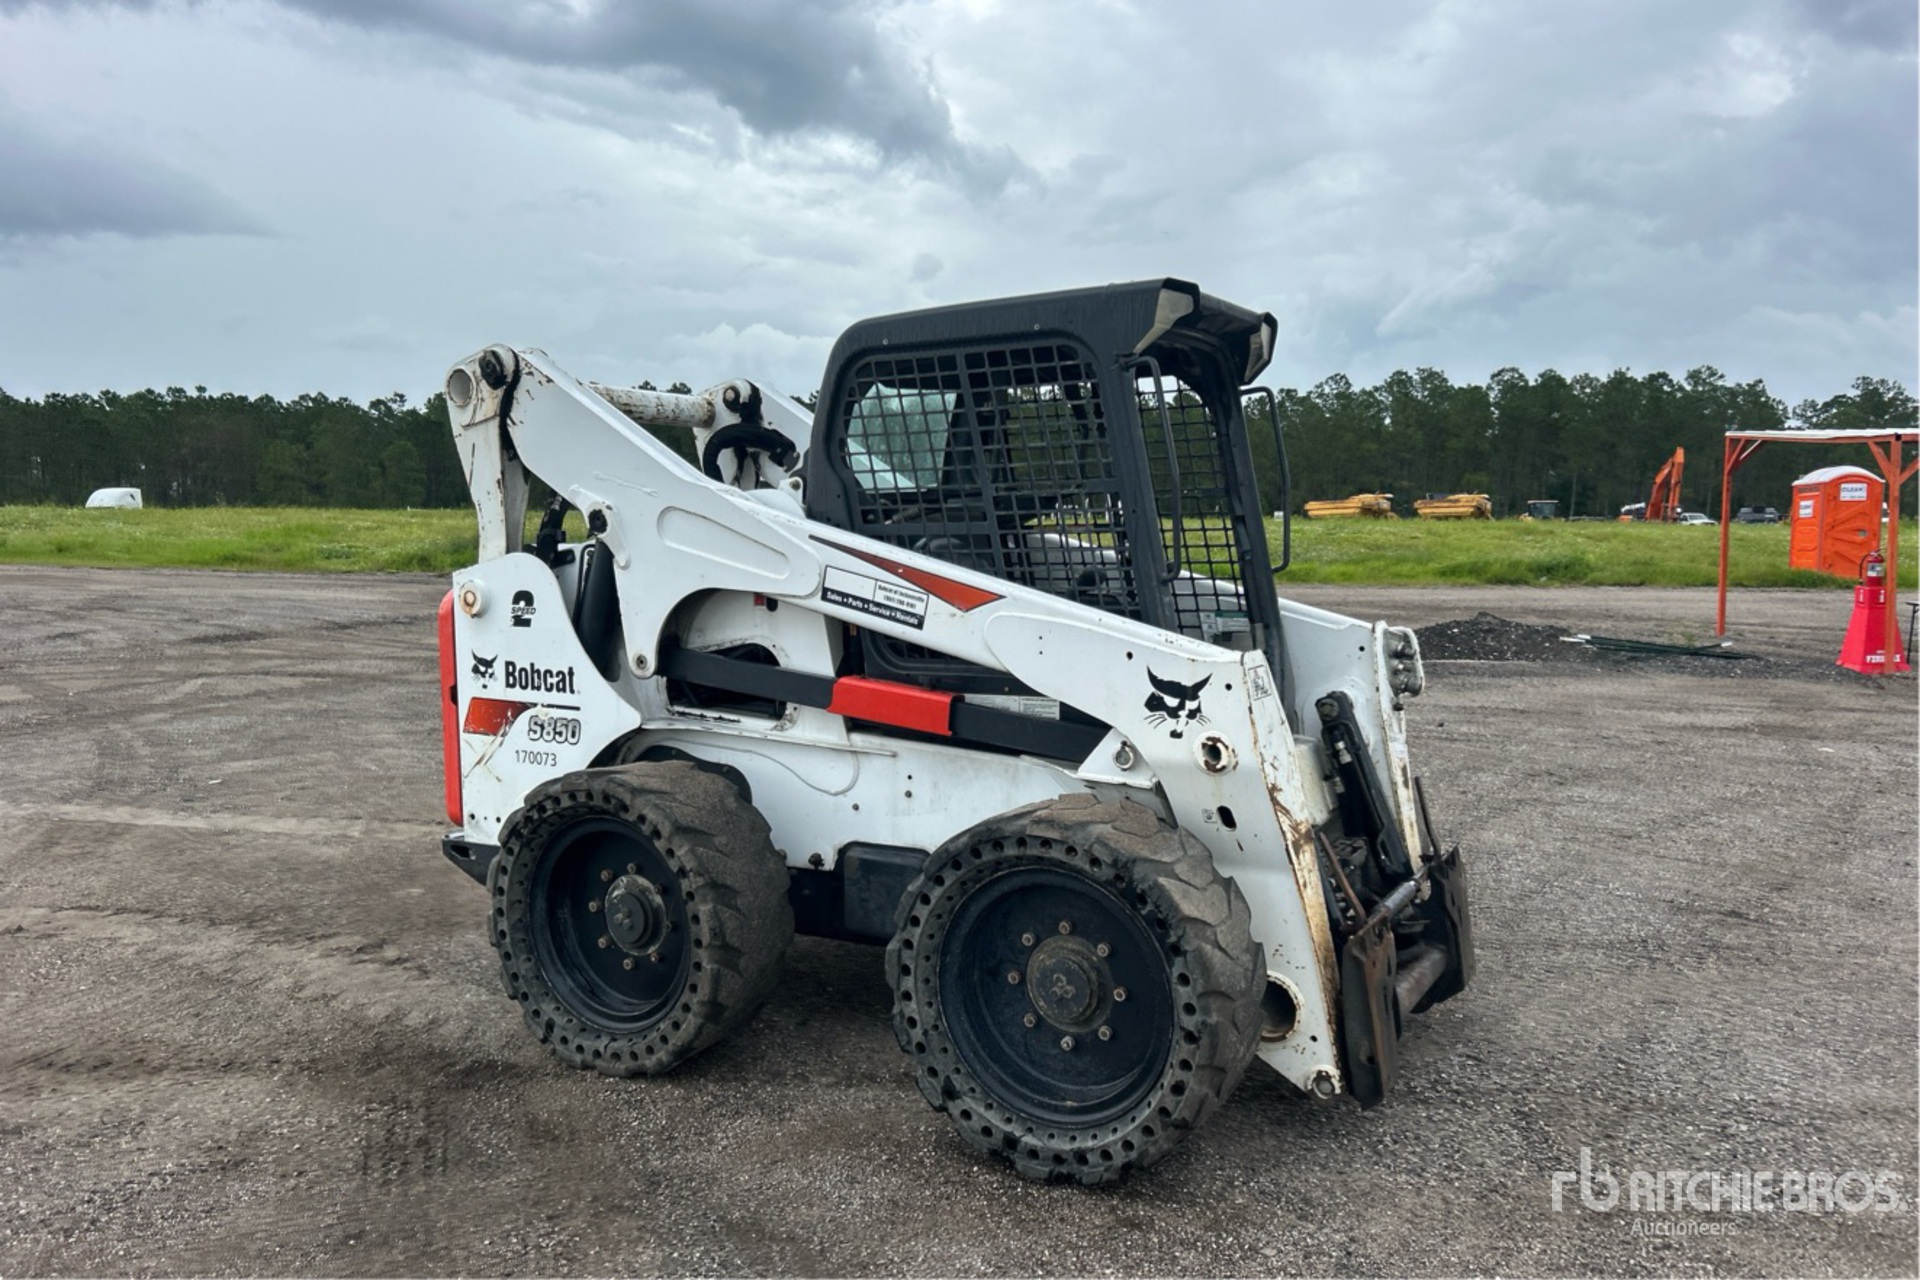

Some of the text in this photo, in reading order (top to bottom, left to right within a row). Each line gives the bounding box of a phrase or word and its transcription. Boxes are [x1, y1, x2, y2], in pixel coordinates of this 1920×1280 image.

[511, 590, 534, 627] 2
[511, 606, 537, 616] SPEED
[827, 591, 842, 602] Sales
[848, 597, 863, 608] Parts
[869, 603, 890, 616] Service
[896, 612, 918, 625] Rentals
[504, 661, 576, 695] Bobcat
[528, 715, 581, 745] S850
[515, 750, 557, 766] 170073
